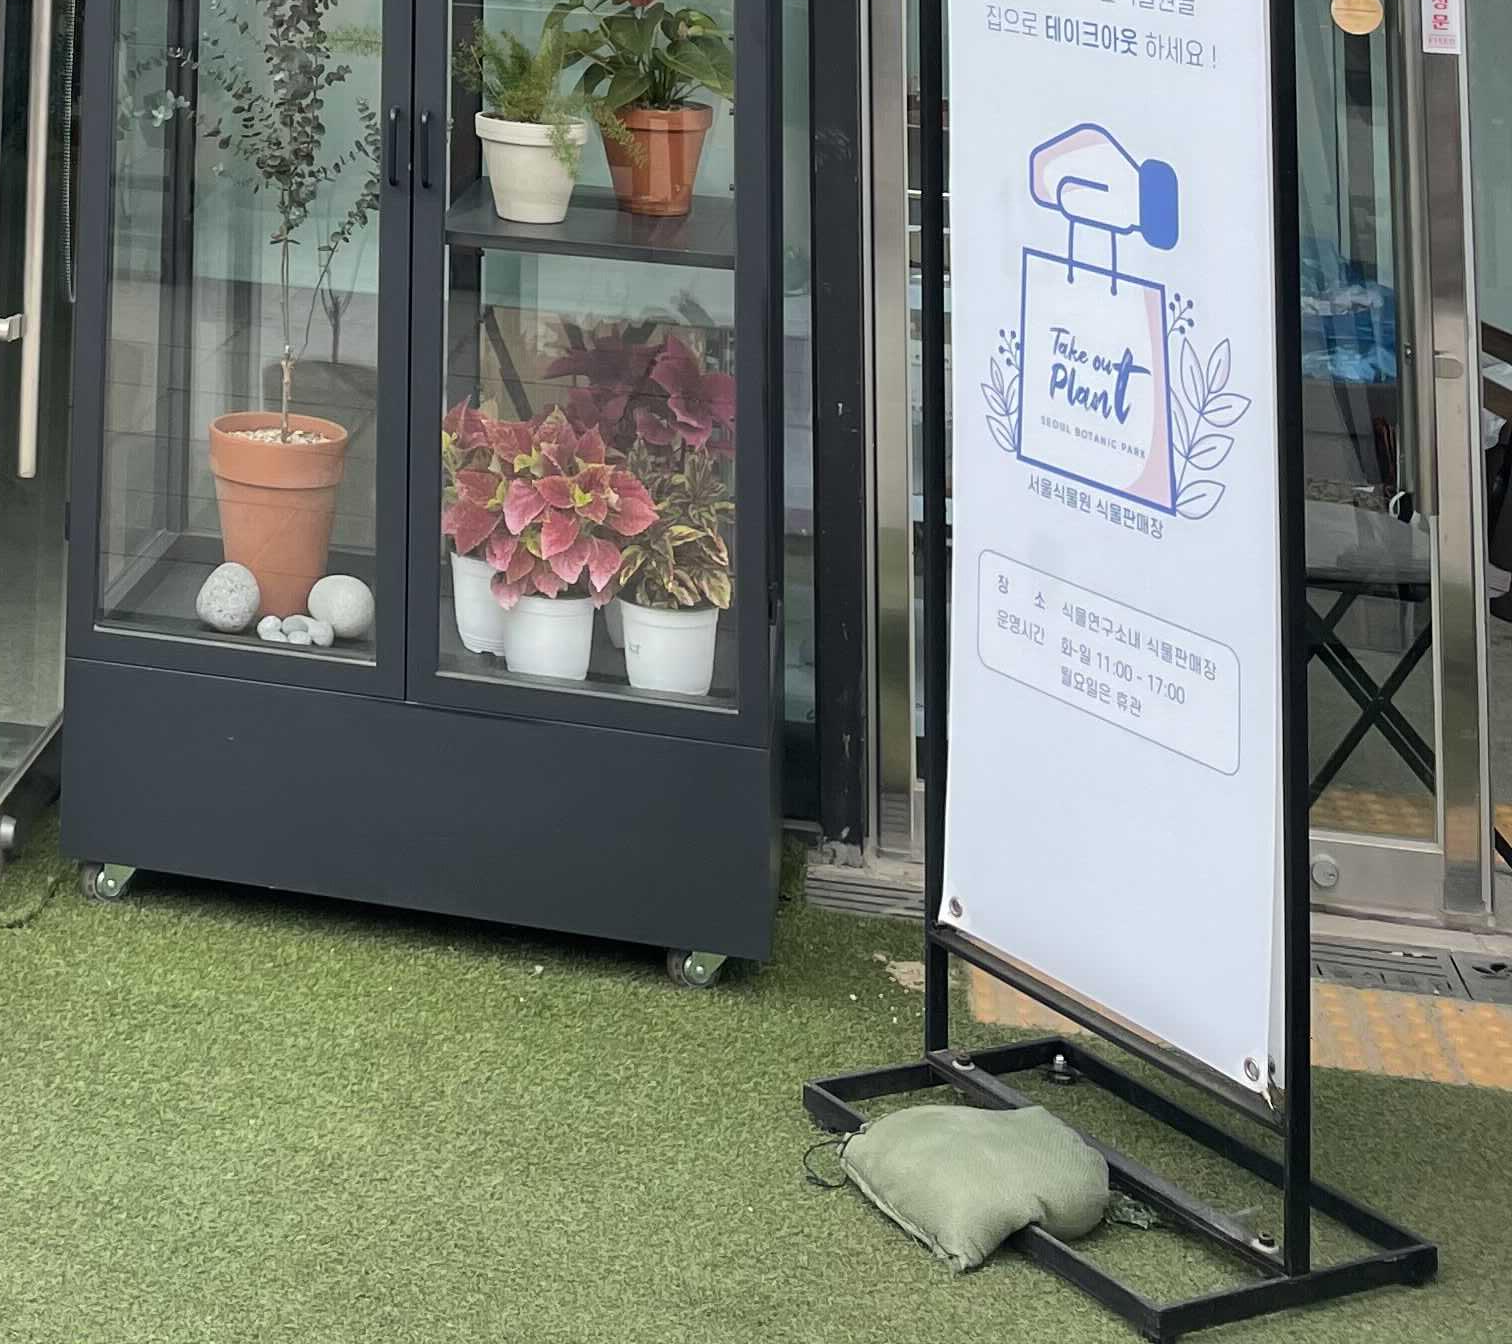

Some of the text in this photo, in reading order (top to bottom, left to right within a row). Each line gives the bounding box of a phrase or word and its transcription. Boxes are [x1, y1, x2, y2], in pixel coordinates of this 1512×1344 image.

[986, 5, 1041, 38] 집으로
[1046, 15, 1138, 56] 테이크아웃
[1049, 326, 1089, 364] Take
[1049, 347, 1151, 425] Plant
[1028, 474, 1163, 539] 서울식물원 식물판매장
[996, 608, 1048, 646] 운영시간
[1096, 652, 1133, 682] 11:00
[1147, 673, 1185, 704] 17:00
